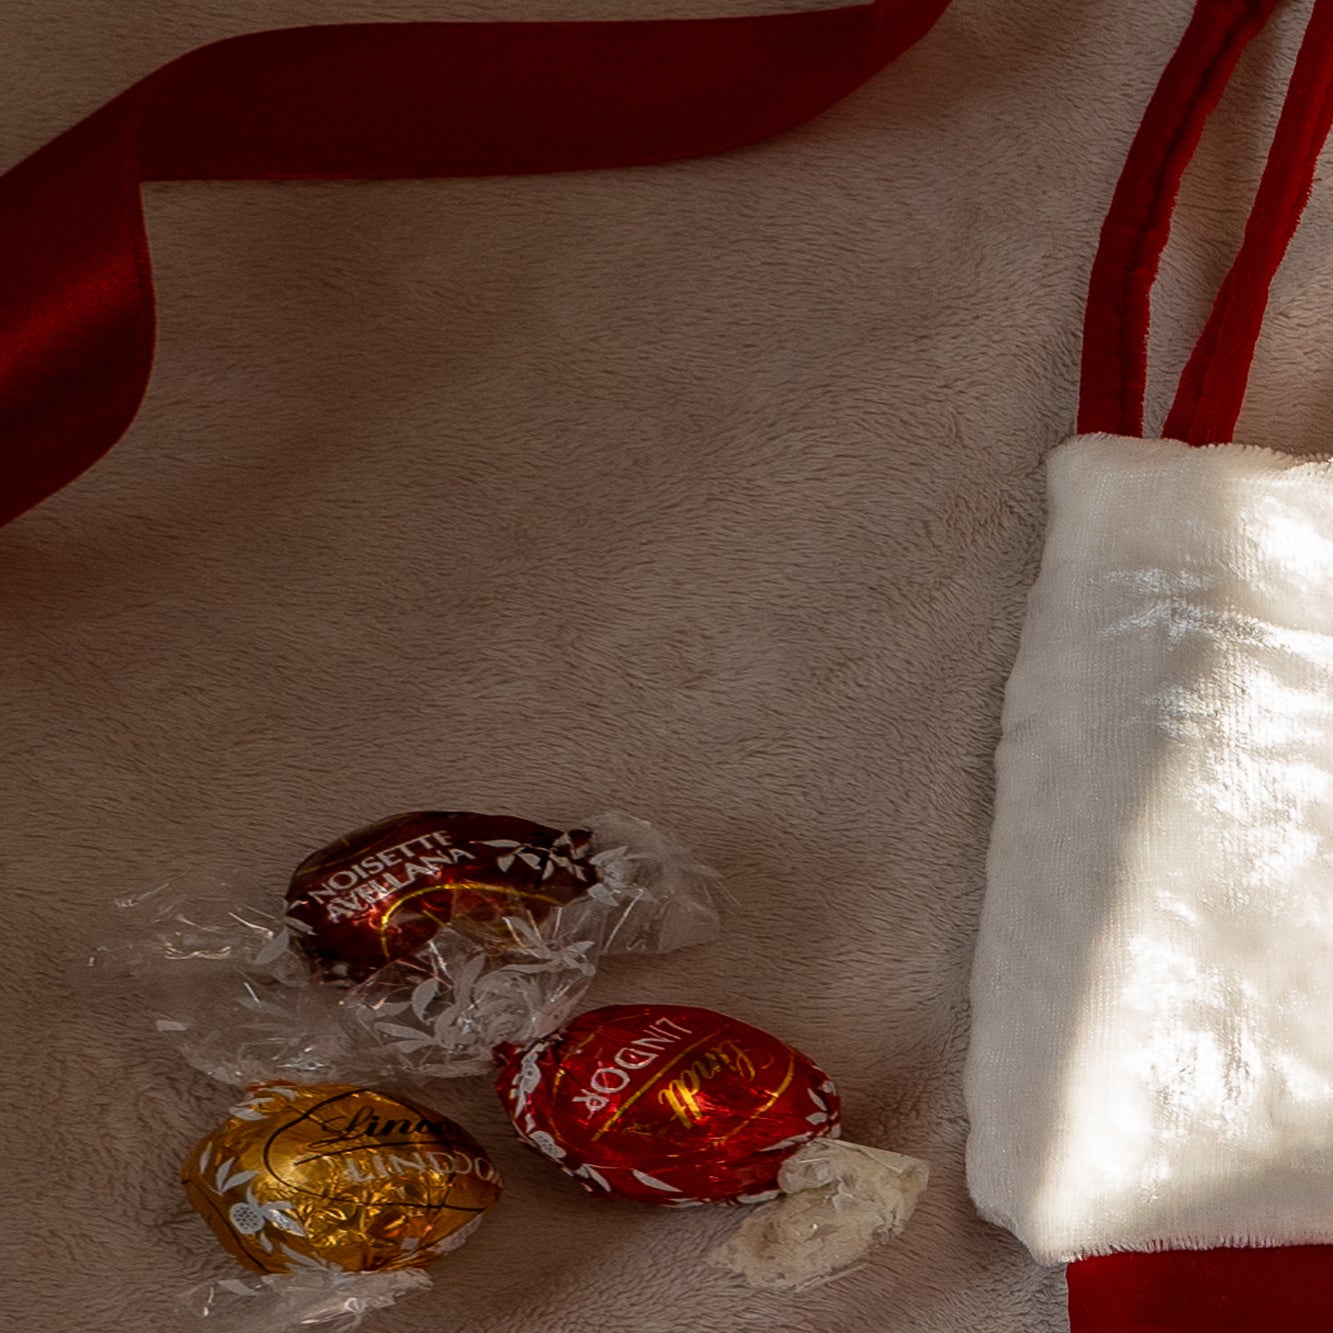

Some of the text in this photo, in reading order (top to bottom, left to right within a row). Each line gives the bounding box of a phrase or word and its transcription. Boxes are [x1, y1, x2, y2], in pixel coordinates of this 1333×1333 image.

[307, 830, 452, 905] NOISETTE
[572, 1017, 693, 1120] LINDOR
[658, 1039, 775, 1129] Lindt
